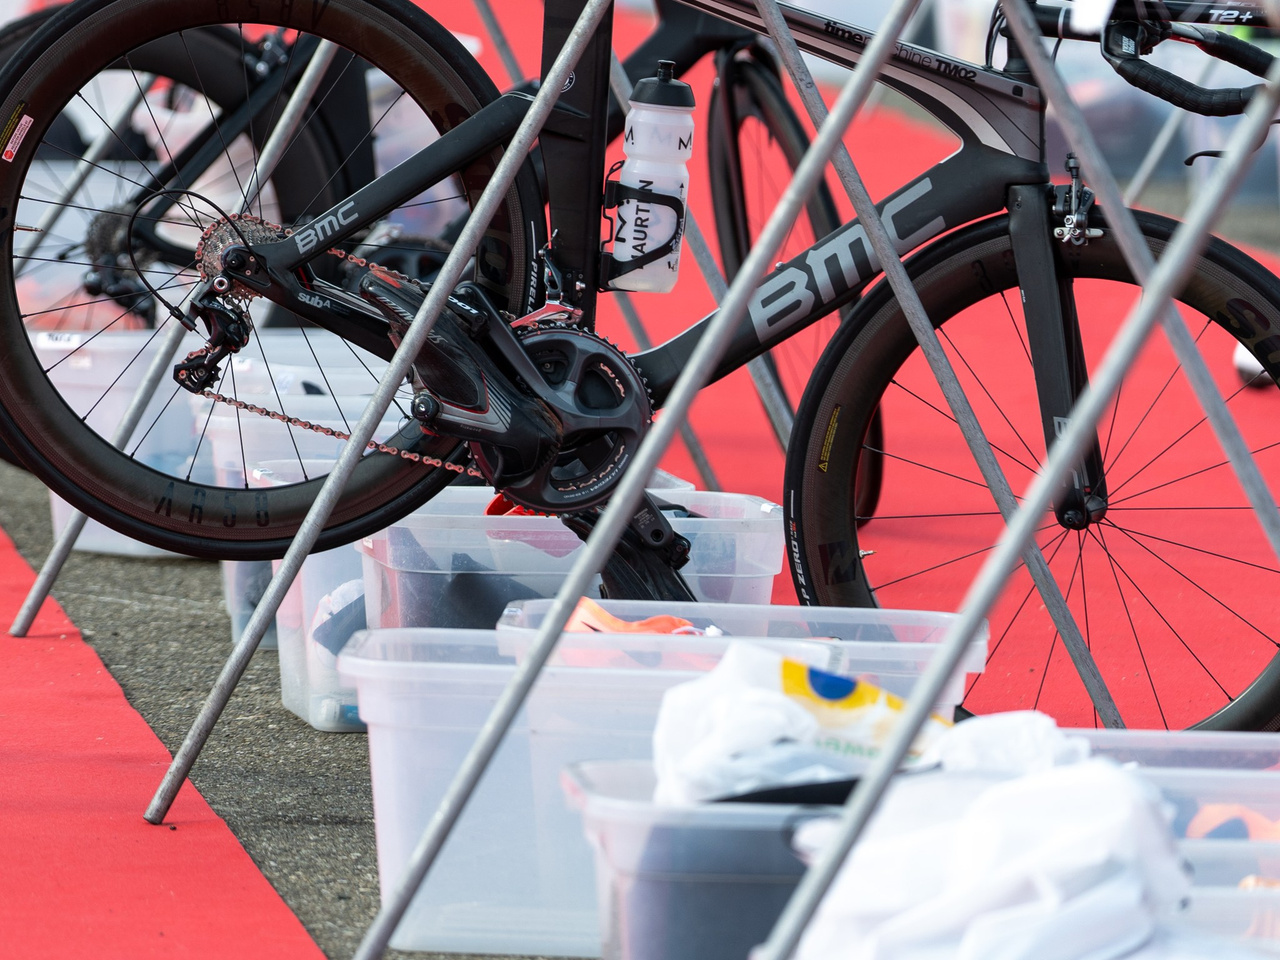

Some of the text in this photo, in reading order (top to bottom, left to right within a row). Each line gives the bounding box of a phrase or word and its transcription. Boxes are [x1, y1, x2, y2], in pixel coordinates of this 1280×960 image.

[1209, 9, 1254, 23] T2+
[935, 58, 978, 83] TM02
[294, 200, 359, 255] BMC
[630, 179, 654, 270] AURTN
[748, 176, 947, 344] BMC
[791, 539, 810, 600] P ZERO
